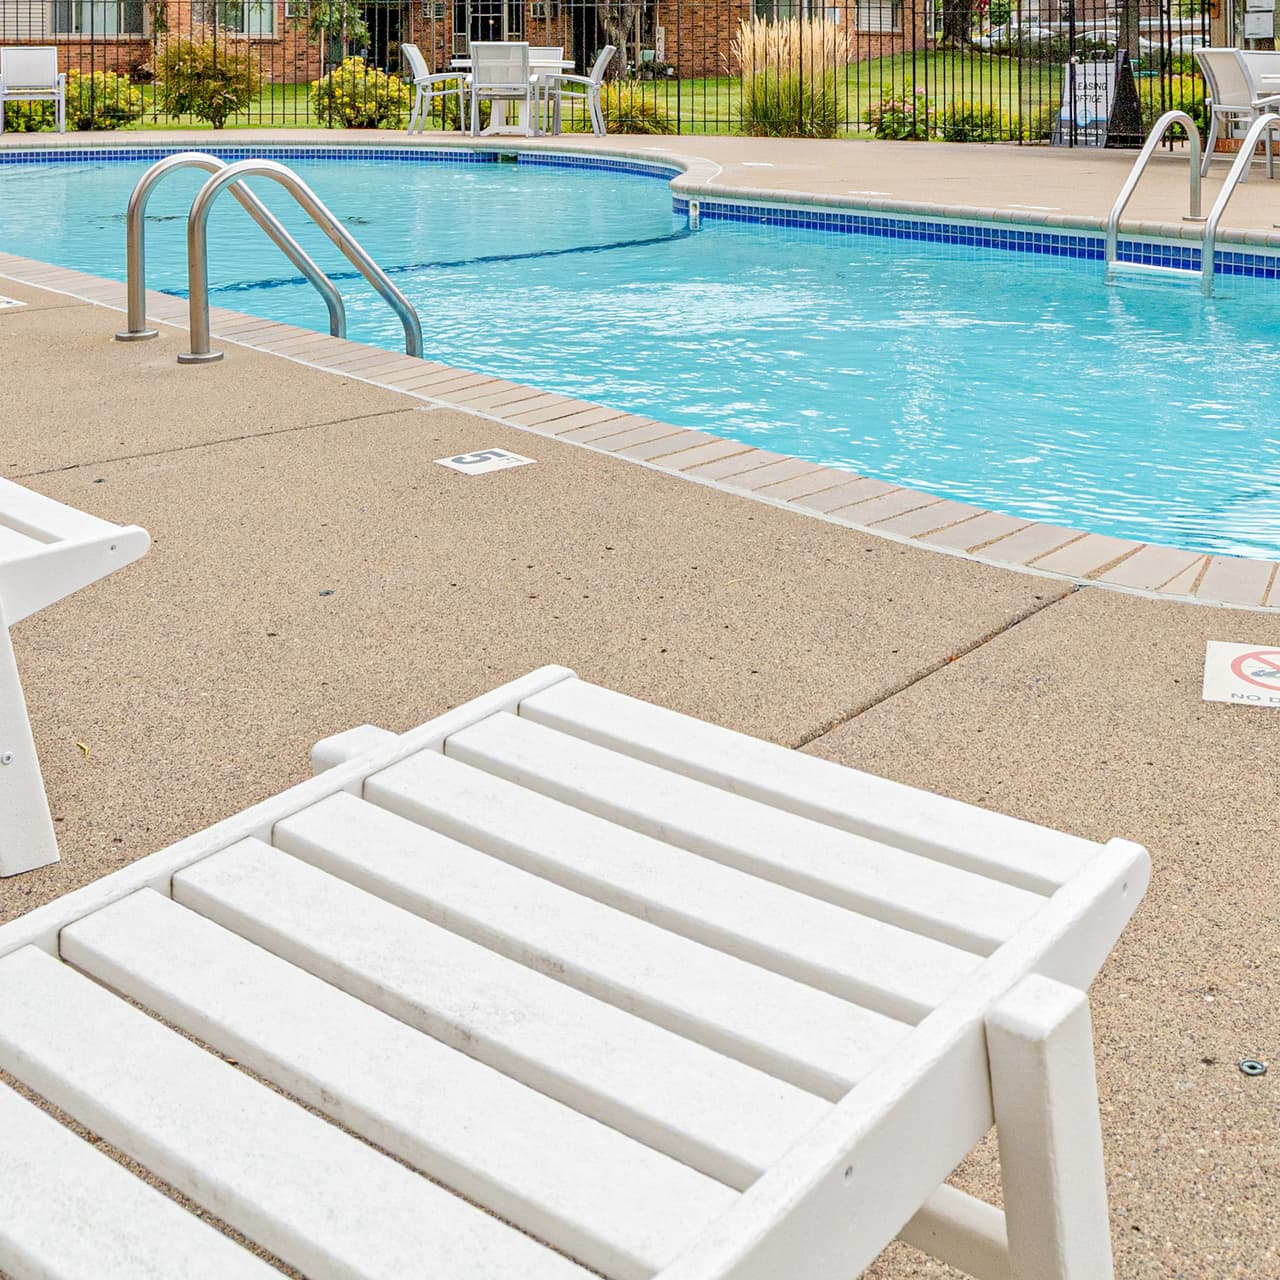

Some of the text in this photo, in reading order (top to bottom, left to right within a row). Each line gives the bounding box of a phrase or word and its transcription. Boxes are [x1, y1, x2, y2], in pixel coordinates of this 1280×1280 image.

[1074, 81, 1107, 91] EASING
[451, 450, 507, 465] 5
[1231, 692, 1262, 703] NO
